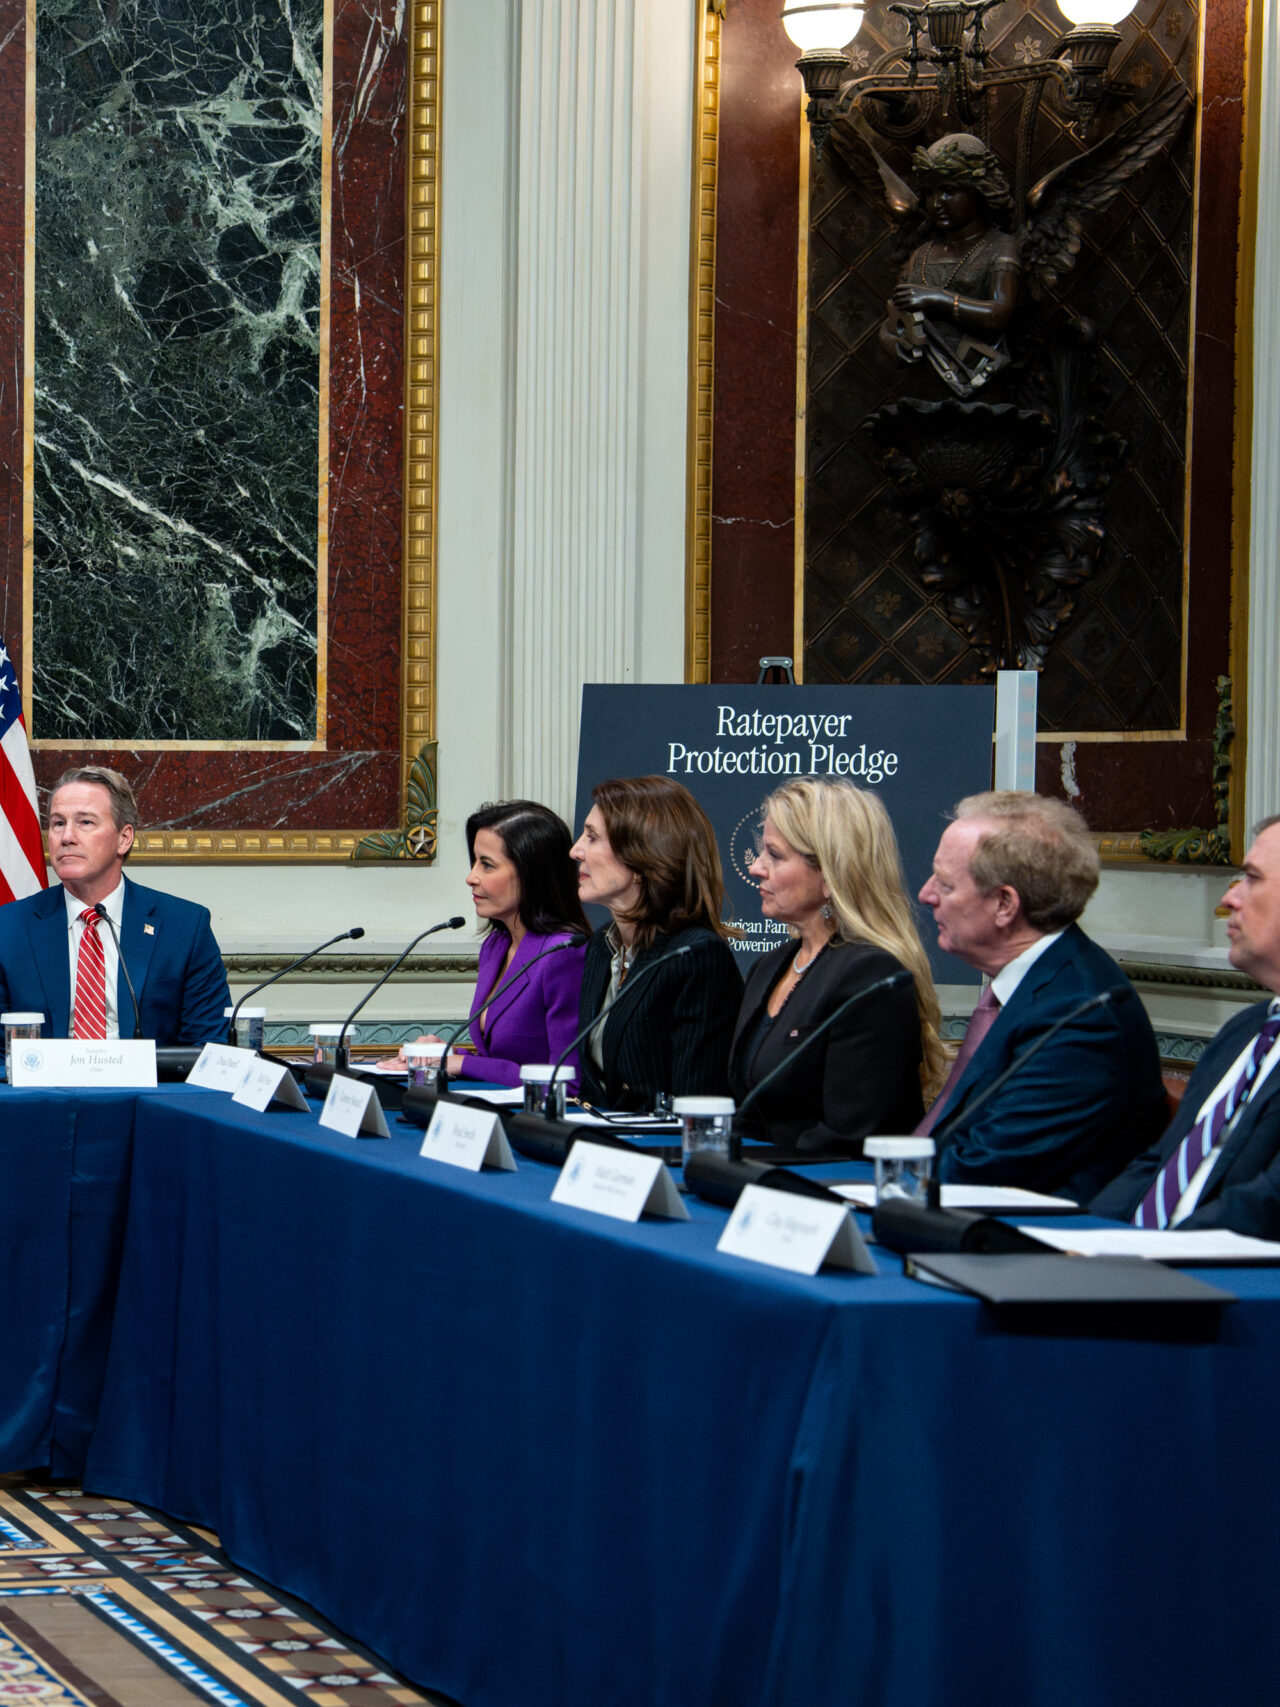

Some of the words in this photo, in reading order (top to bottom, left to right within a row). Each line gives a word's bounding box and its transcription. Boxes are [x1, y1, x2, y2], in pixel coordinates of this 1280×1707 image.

[715, 705, 853, 745] Ratepayer
[667, 742, 802, 775] Protection
[808, 744, 899, 784] Pledge
[720, 918, 762, 933] erican
[764, 919, 790, 933] Fam
[70, 1054, 86, 1066] Jon
[88, 1054, 124, 1065] Husted
